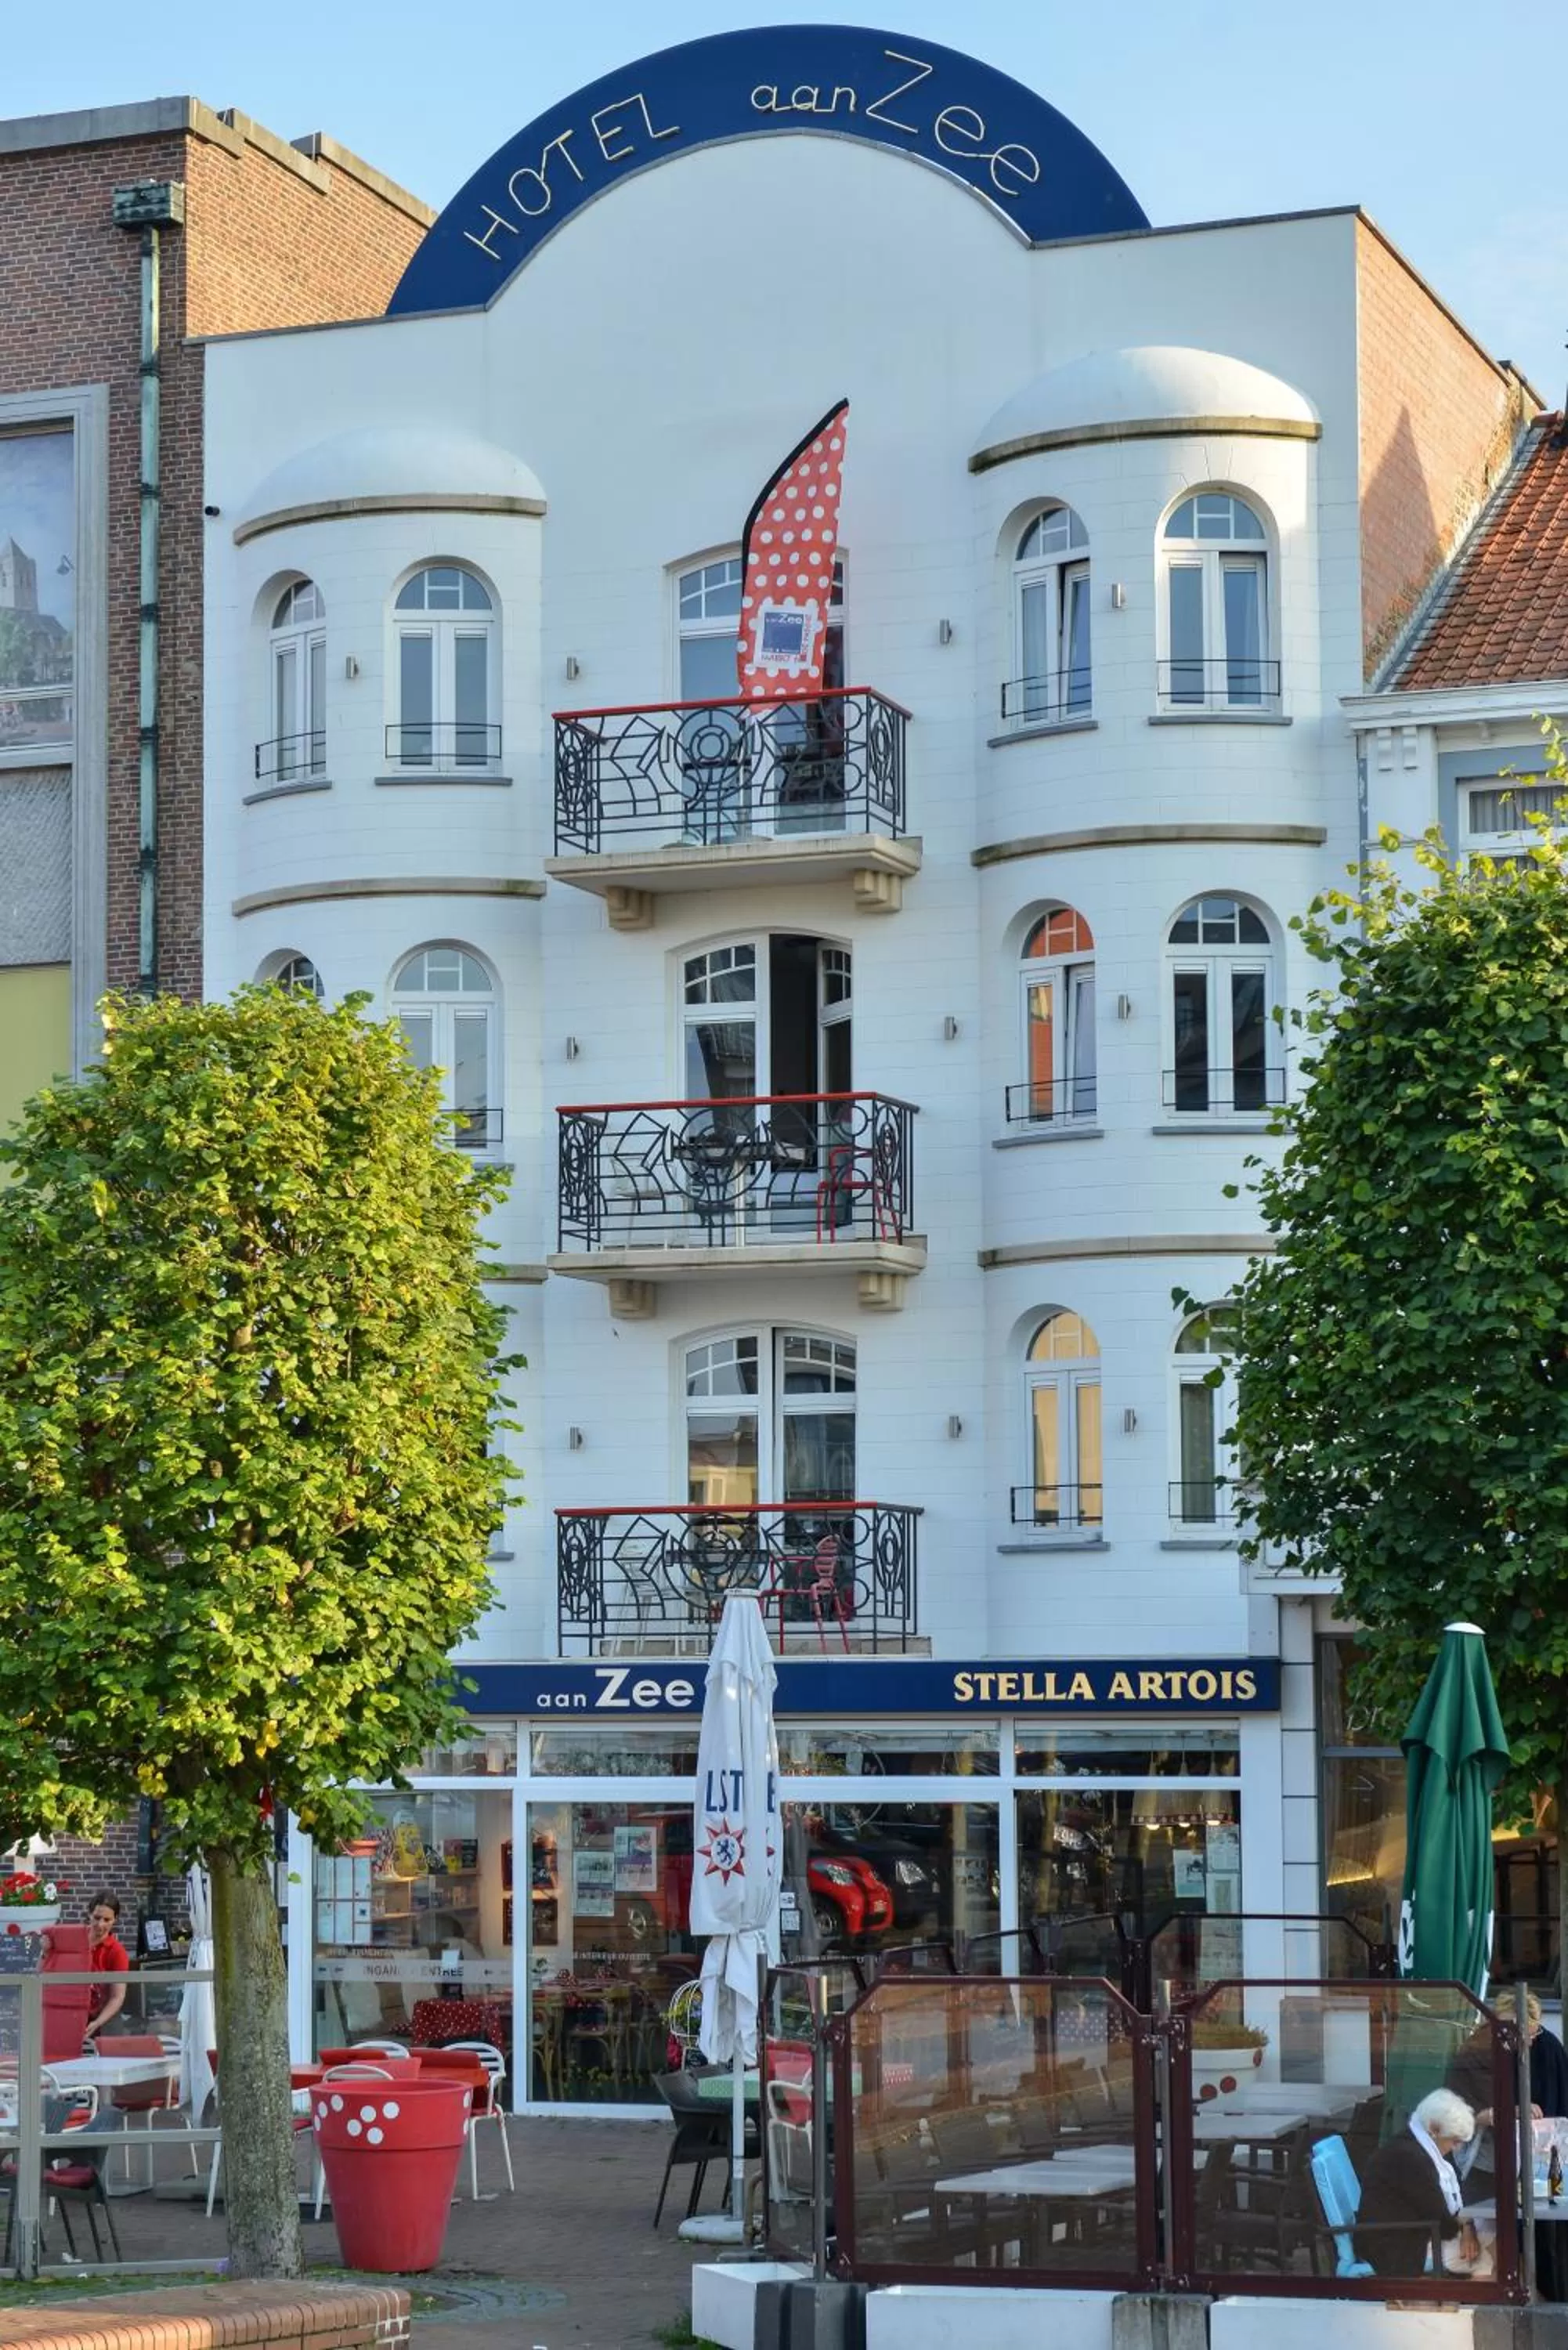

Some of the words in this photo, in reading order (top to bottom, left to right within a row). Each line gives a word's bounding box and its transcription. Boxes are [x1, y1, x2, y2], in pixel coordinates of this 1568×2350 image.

[464, 93, 680, 261] HOTEL
[537, 1694, 587, 1708] aan
[594, 1668, 695, 1708] Zee
[953, 1671, 1097, 1701] STELLA
[1107, 1669, 1258, 1701] ARTOIS
[363, 1964, 403, 1976] INGAN
